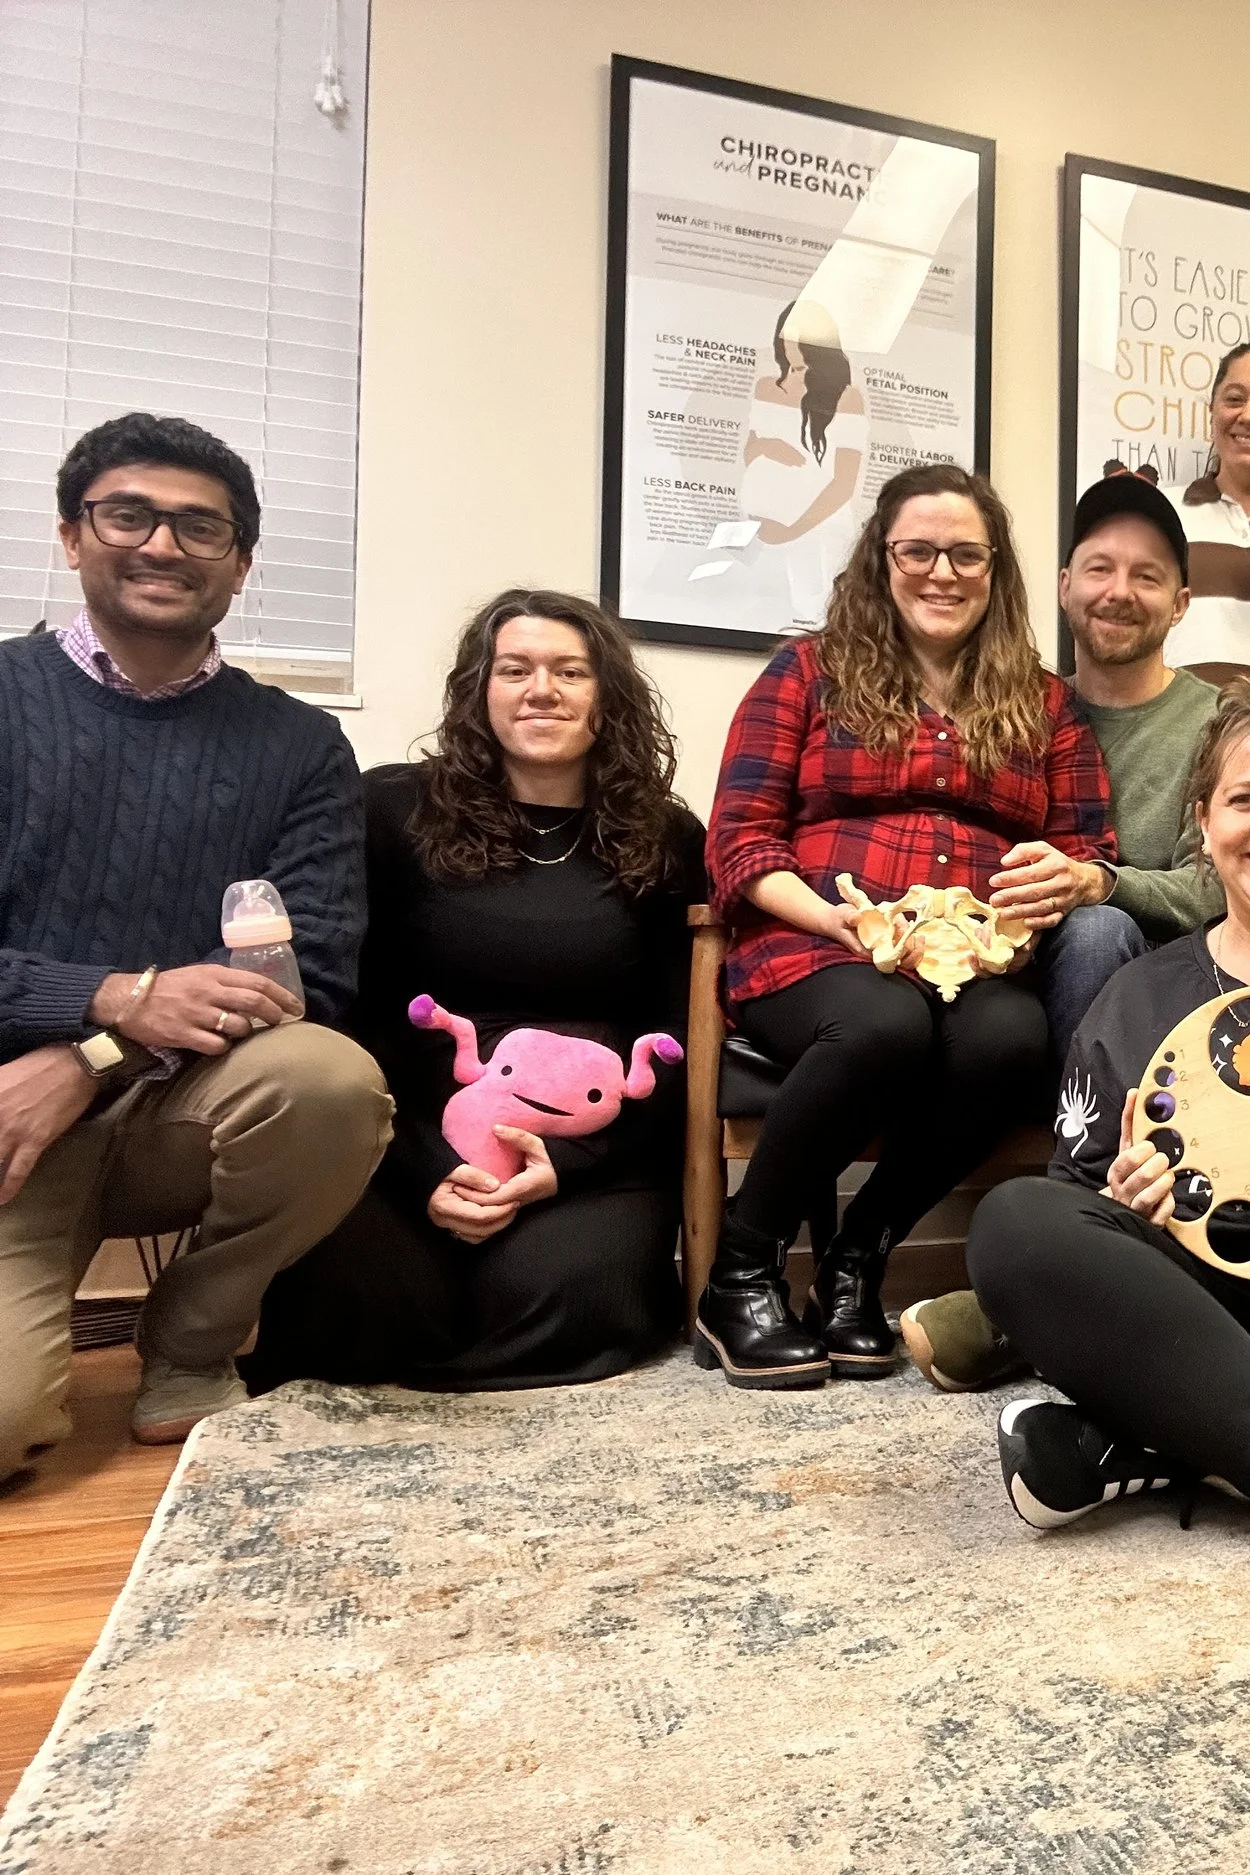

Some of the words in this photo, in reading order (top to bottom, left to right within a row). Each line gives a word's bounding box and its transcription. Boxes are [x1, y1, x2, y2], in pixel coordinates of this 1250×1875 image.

[720, 136, 878, 182] CHIROPRACT
[757, 165, 871, 202] PREGNAN
[656, 212, 688, 225] WHAT
[690, 217, 710, 230] ARE
[713, 222, 732, 233] THE
[734, 226, 783, 243] BENEFITS
[1120, 247, 1158, 288] T'S
[656, 333, 684, 345] LESS
[686, 338, 757, 356] HEADACHES
[684, 348, 691, 357] &
[695, 349, 726, 362] NECK
[729, 355, 756, 367] PAIN
[1115, 338, 1214, 392] STRO
[863, 367, 905, 381] OPTIMAL
[866, 377, 897, 391] FETAL
[900, 383, 949, 399] POSITION
[647, 410, 685, 423] SAFER
[688, 415, 741, 429] DELIVERY
[869, 452, 876, 460] &
[879, 453, 929, 468] DELIVERY
[870, 442, 918, 457] SHORTER
[920, 450, 954, 463] LABOR
[643, 476, 672, 488] LESS
[674, 480, 706, 492] BACK
[709, 484, 736, 496] PAIN
[1179, 1049, 1186, 1060] 1
[1179, 1070, 1188, 1082] 2
[1180, 1099, 1190, 1111] 3
[1190, 1137, 1200, 1148] 4
[1211, 1166, 1220, 1179] 5
